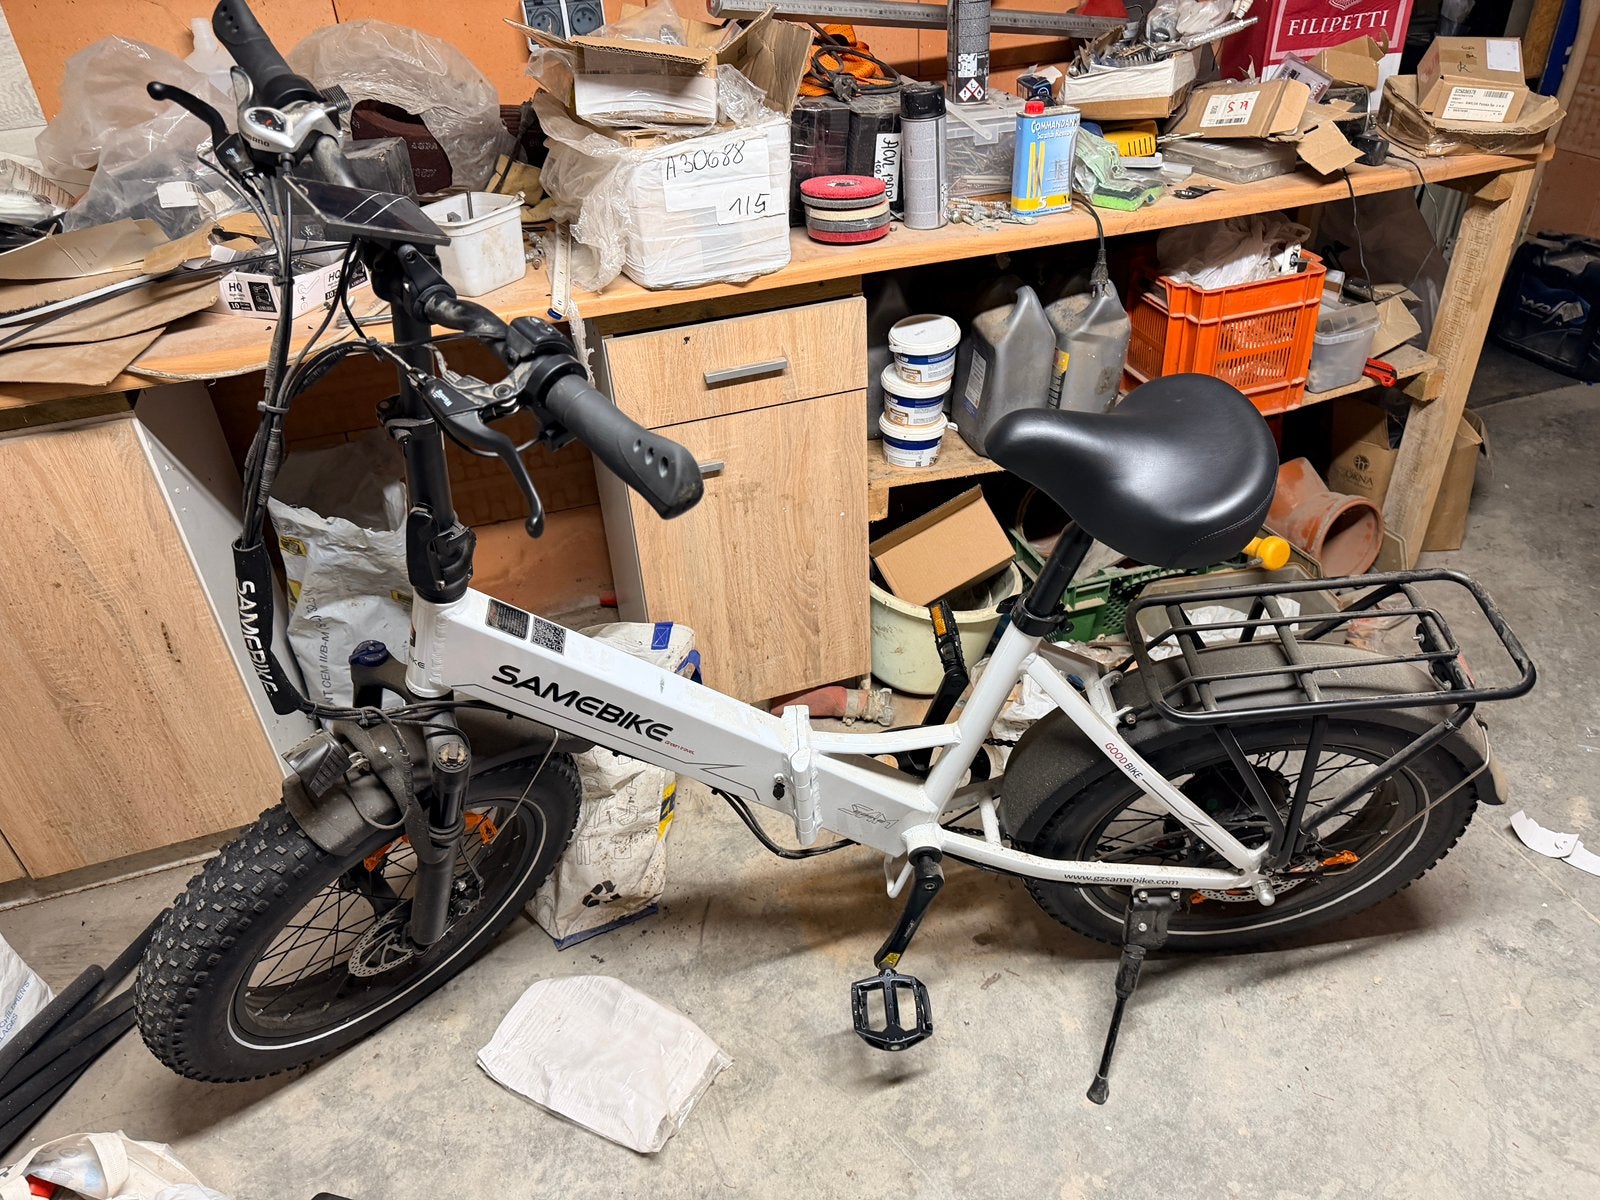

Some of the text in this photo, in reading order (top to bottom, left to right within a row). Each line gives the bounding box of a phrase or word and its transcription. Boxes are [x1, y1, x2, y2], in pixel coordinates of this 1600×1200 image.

[1287, 10, 1389, 36] FILIPETTI
[228, 282, 243, 292] HQ
[237, 580, 278, 694] SAMEBIKE
[319, 664, 332, 689] CEM
[491, 664, 674, 742] SAMEBIKE
[1105, 742, 1144, 779] GOOD BIKE
[1064, 873, 1179, 886] www.gzsamebike.com
